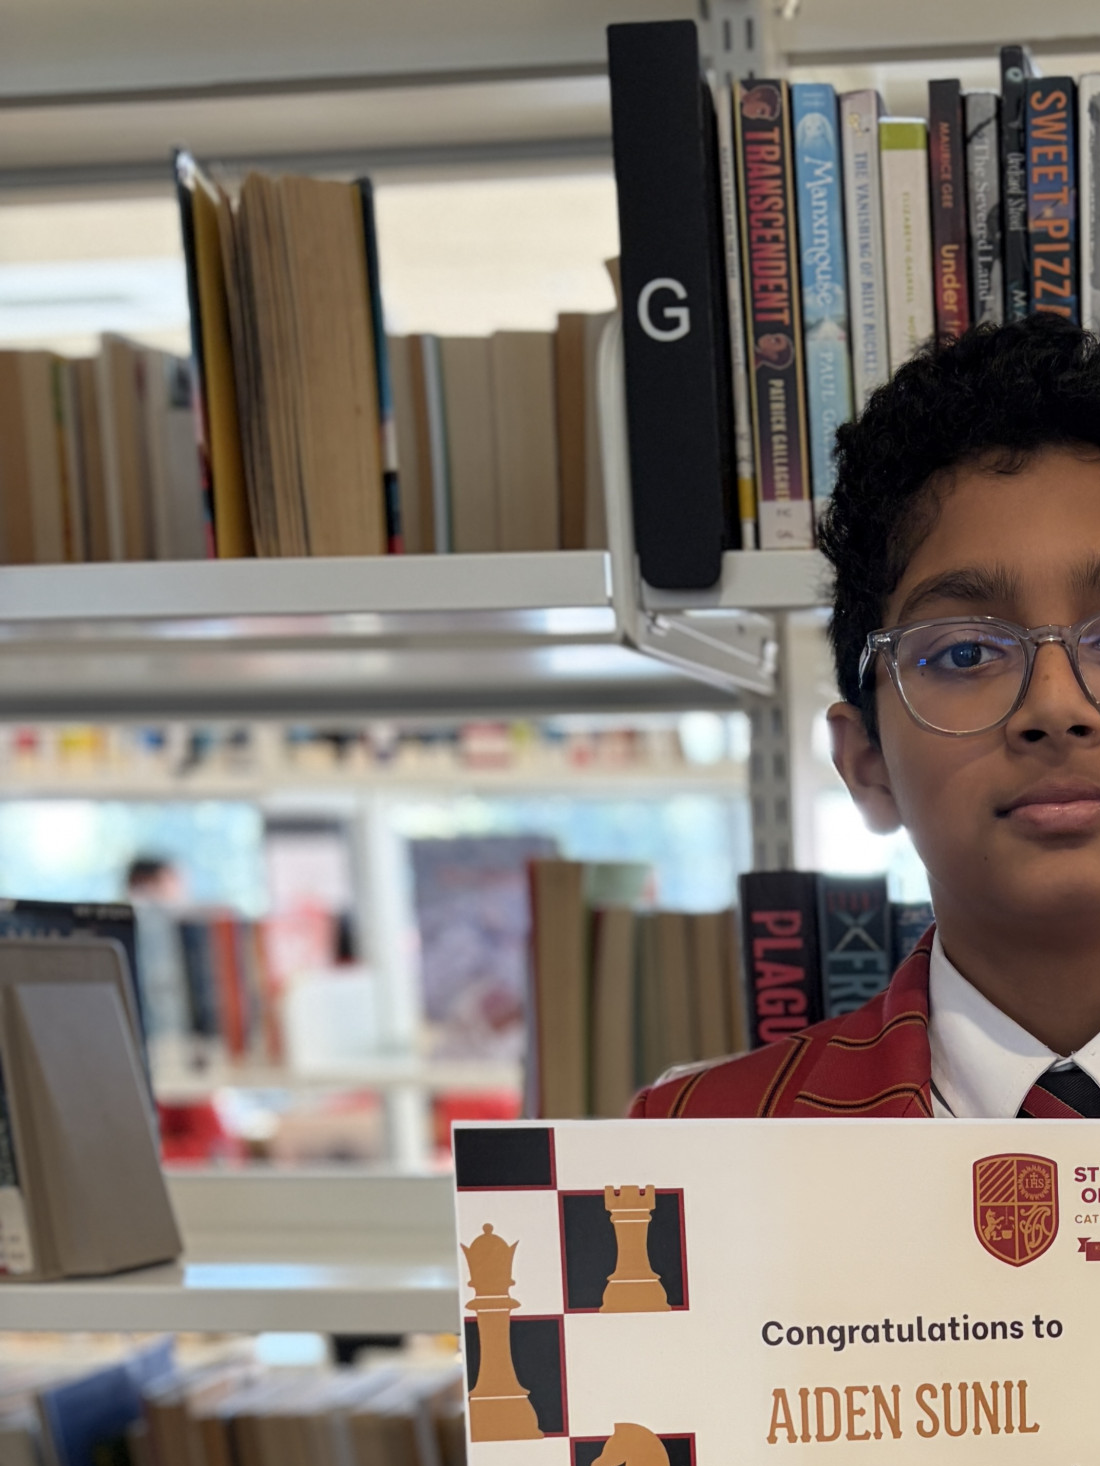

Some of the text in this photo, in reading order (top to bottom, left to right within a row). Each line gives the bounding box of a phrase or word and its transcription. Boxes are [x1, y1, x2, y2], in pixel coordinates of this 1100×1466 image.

[854, 152, 871, 179] THE
[938, 122, 953, 208] MAURICE GEE
[1031, 90, 1069, 205] SWEET
[744, 126, 791, 327] TRANSCENDENT
[803, 155, 838, 308] Manxmouse
[855, 184, 874, 258] VANISHING
[973, 139, 995, 302] The Severed Land
[859, 262, 874, 277] OF
[861, 281, 878, 319] BILLY
[637, 277, 691, 342] G
[768, 379, 793, 501] PATRICK GALLAGHE
[752, 910, 809, 1042] PLAGU
[1074, 1166, 1100, 1183] ST
[762, 1314, 1064, 1351] Congratulations to
[766, 1379, 1041, 1445] AIDEN SUNIL
